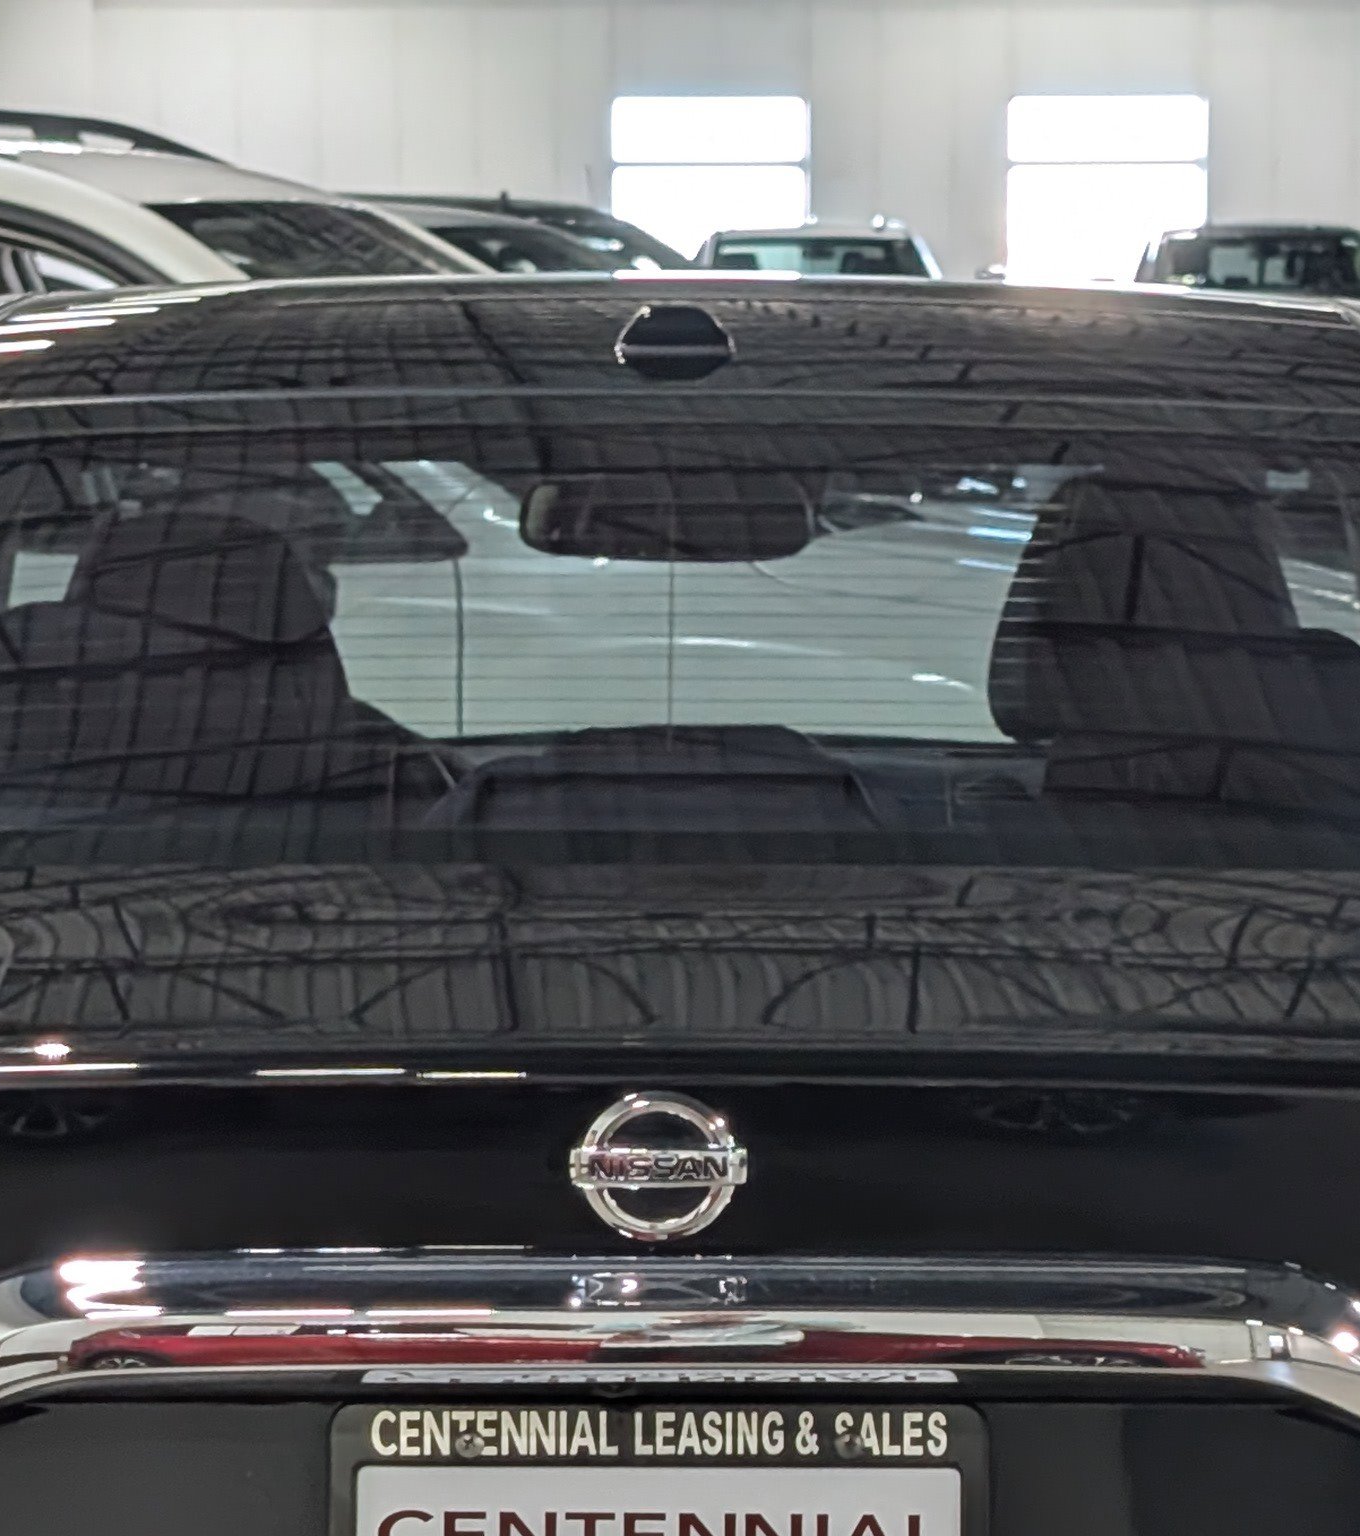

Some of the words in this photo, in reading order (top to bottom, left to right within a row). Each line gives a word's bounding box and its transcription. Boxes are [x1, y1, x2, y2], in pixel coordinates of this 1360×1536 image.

[589, 1152, 729, 1182] NISSAN
[371, 1410, 619, 1457] CENTENNIAL
[634, 1410, 785, 1456] LEASING
[795, 1410, 820, 1456] &
